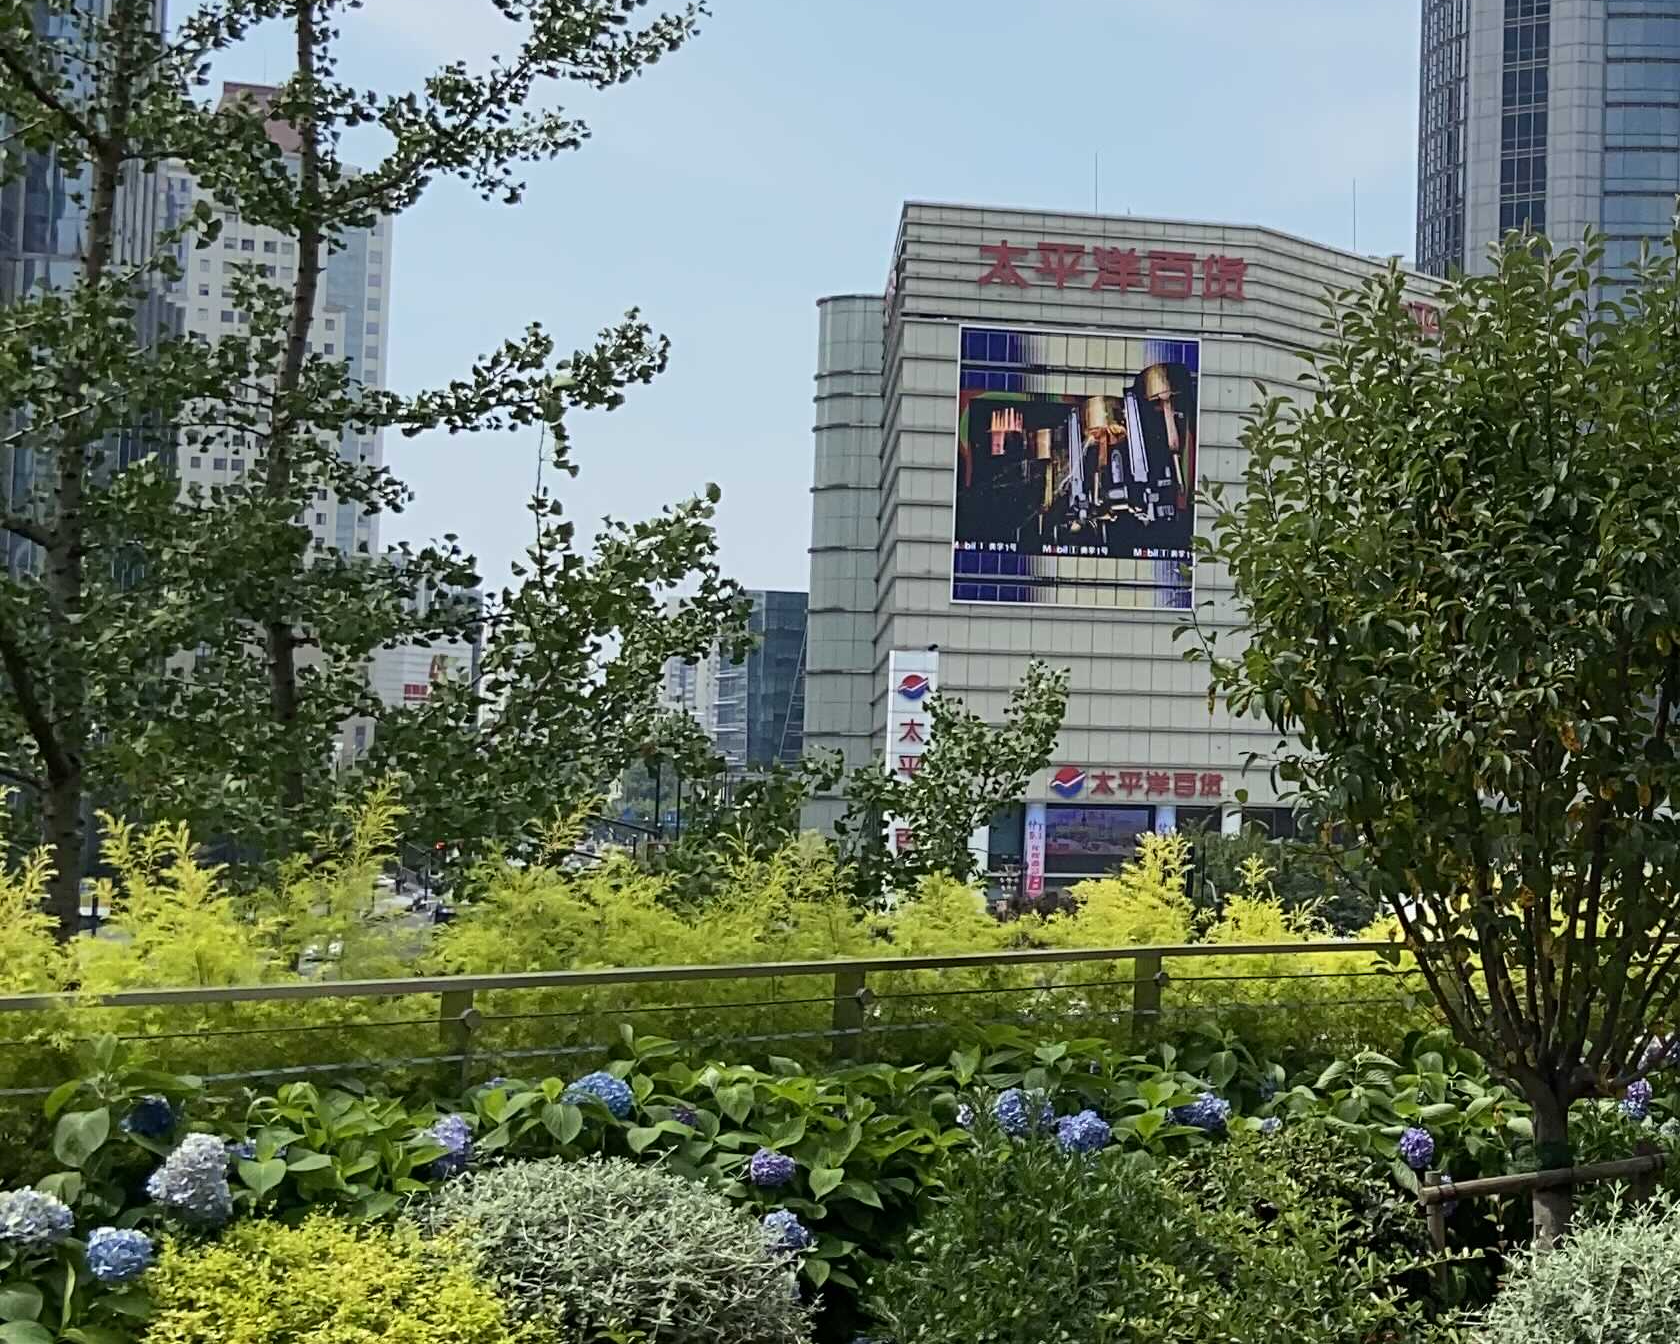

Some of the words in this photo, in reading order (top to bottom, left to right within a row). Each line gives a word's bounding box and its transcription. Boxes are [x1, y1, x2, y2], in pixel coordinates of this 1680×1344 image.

[977, 240, 1248, 302] 太平洋百货
[1091, 770, 1224, 798] 太平洋百货
